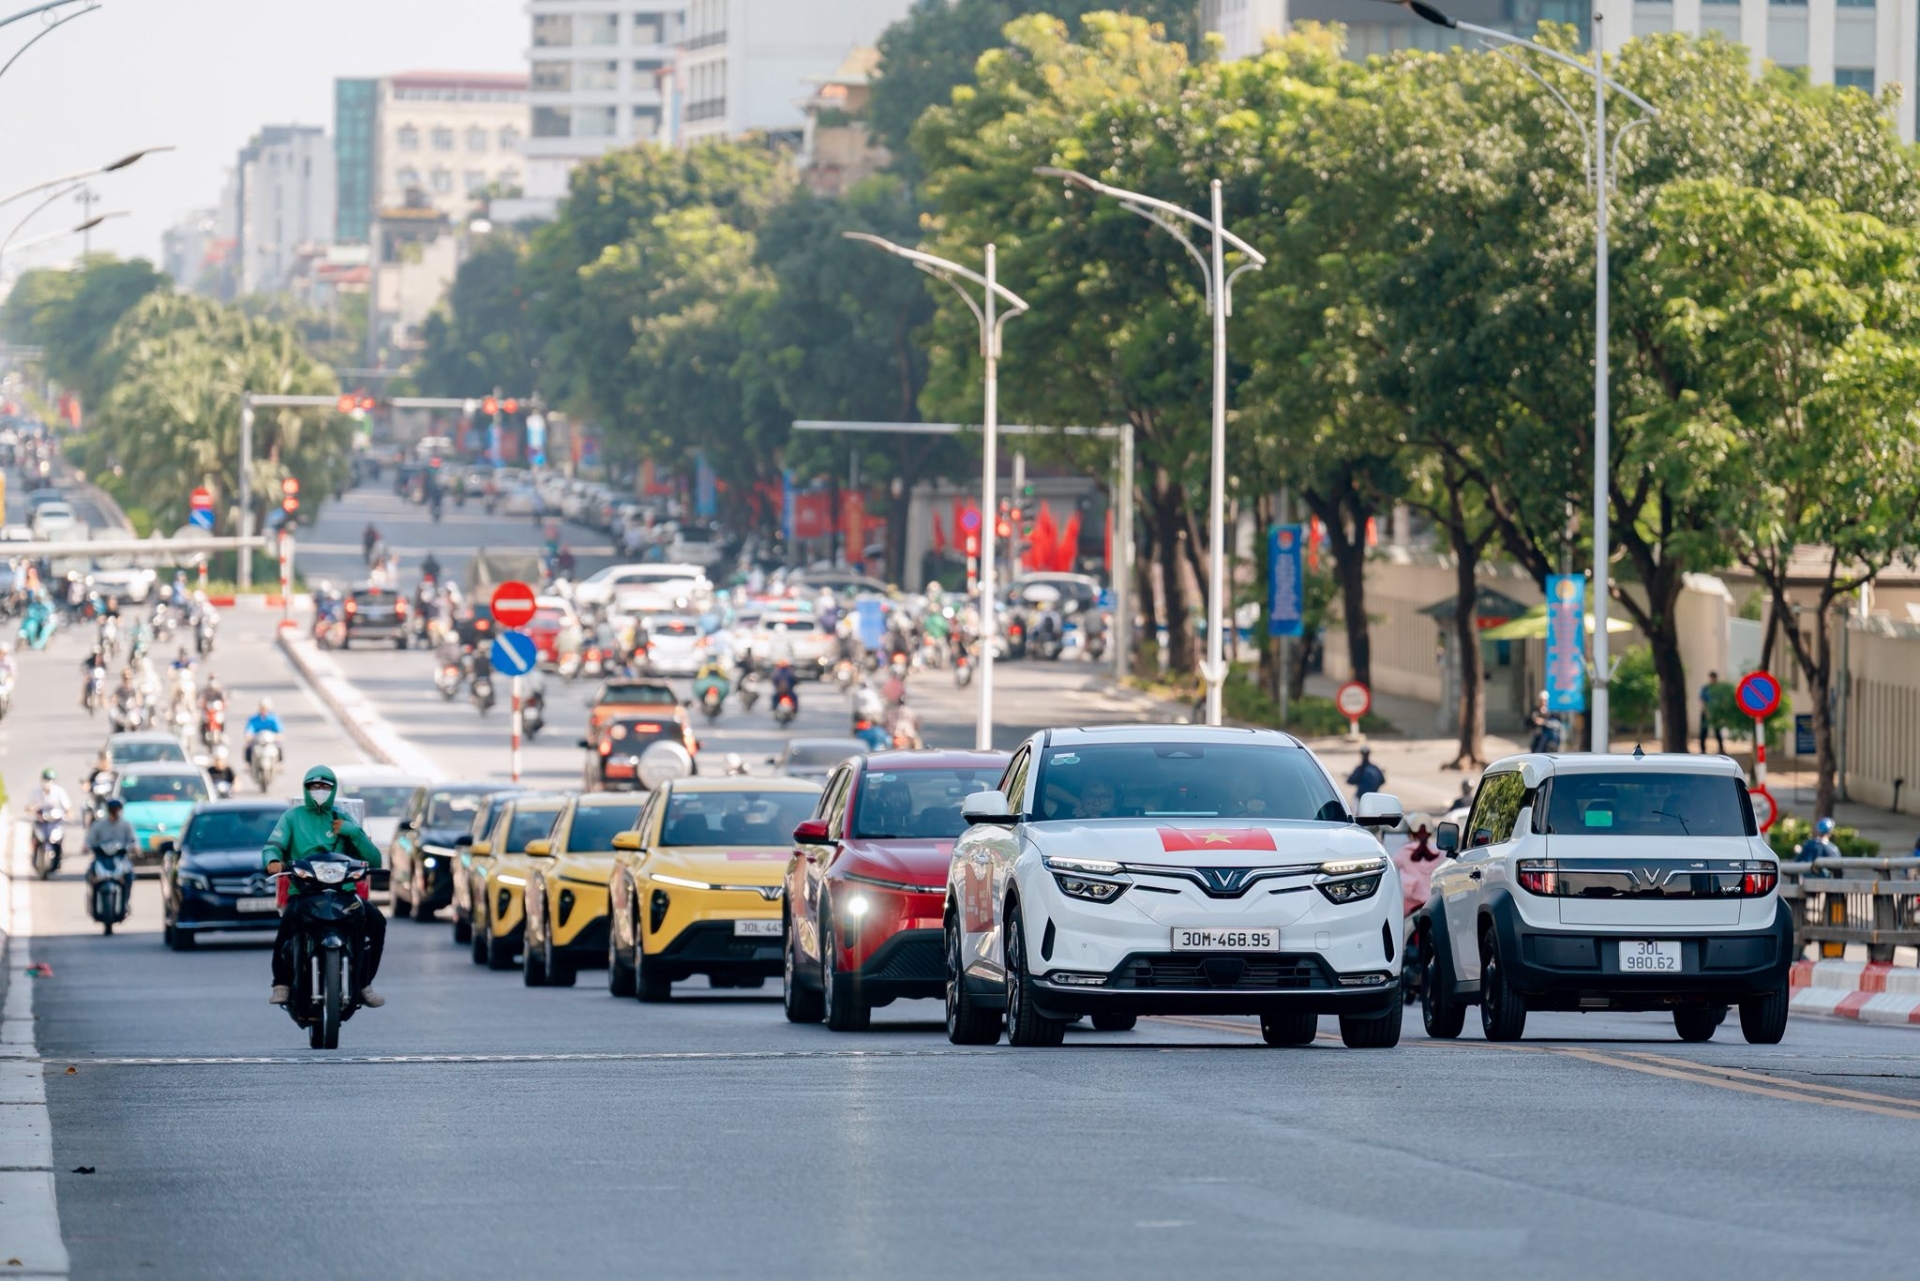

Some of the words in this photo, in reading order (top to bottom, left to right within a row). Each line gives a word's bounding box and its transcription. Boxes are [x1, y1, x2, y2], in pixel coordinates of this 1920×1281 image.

[1182, 932, 1271, 947] 30M-468.95
[1637, 942, 1663, 955] 30L
[1627, 957, 1674, 970] 980.62
